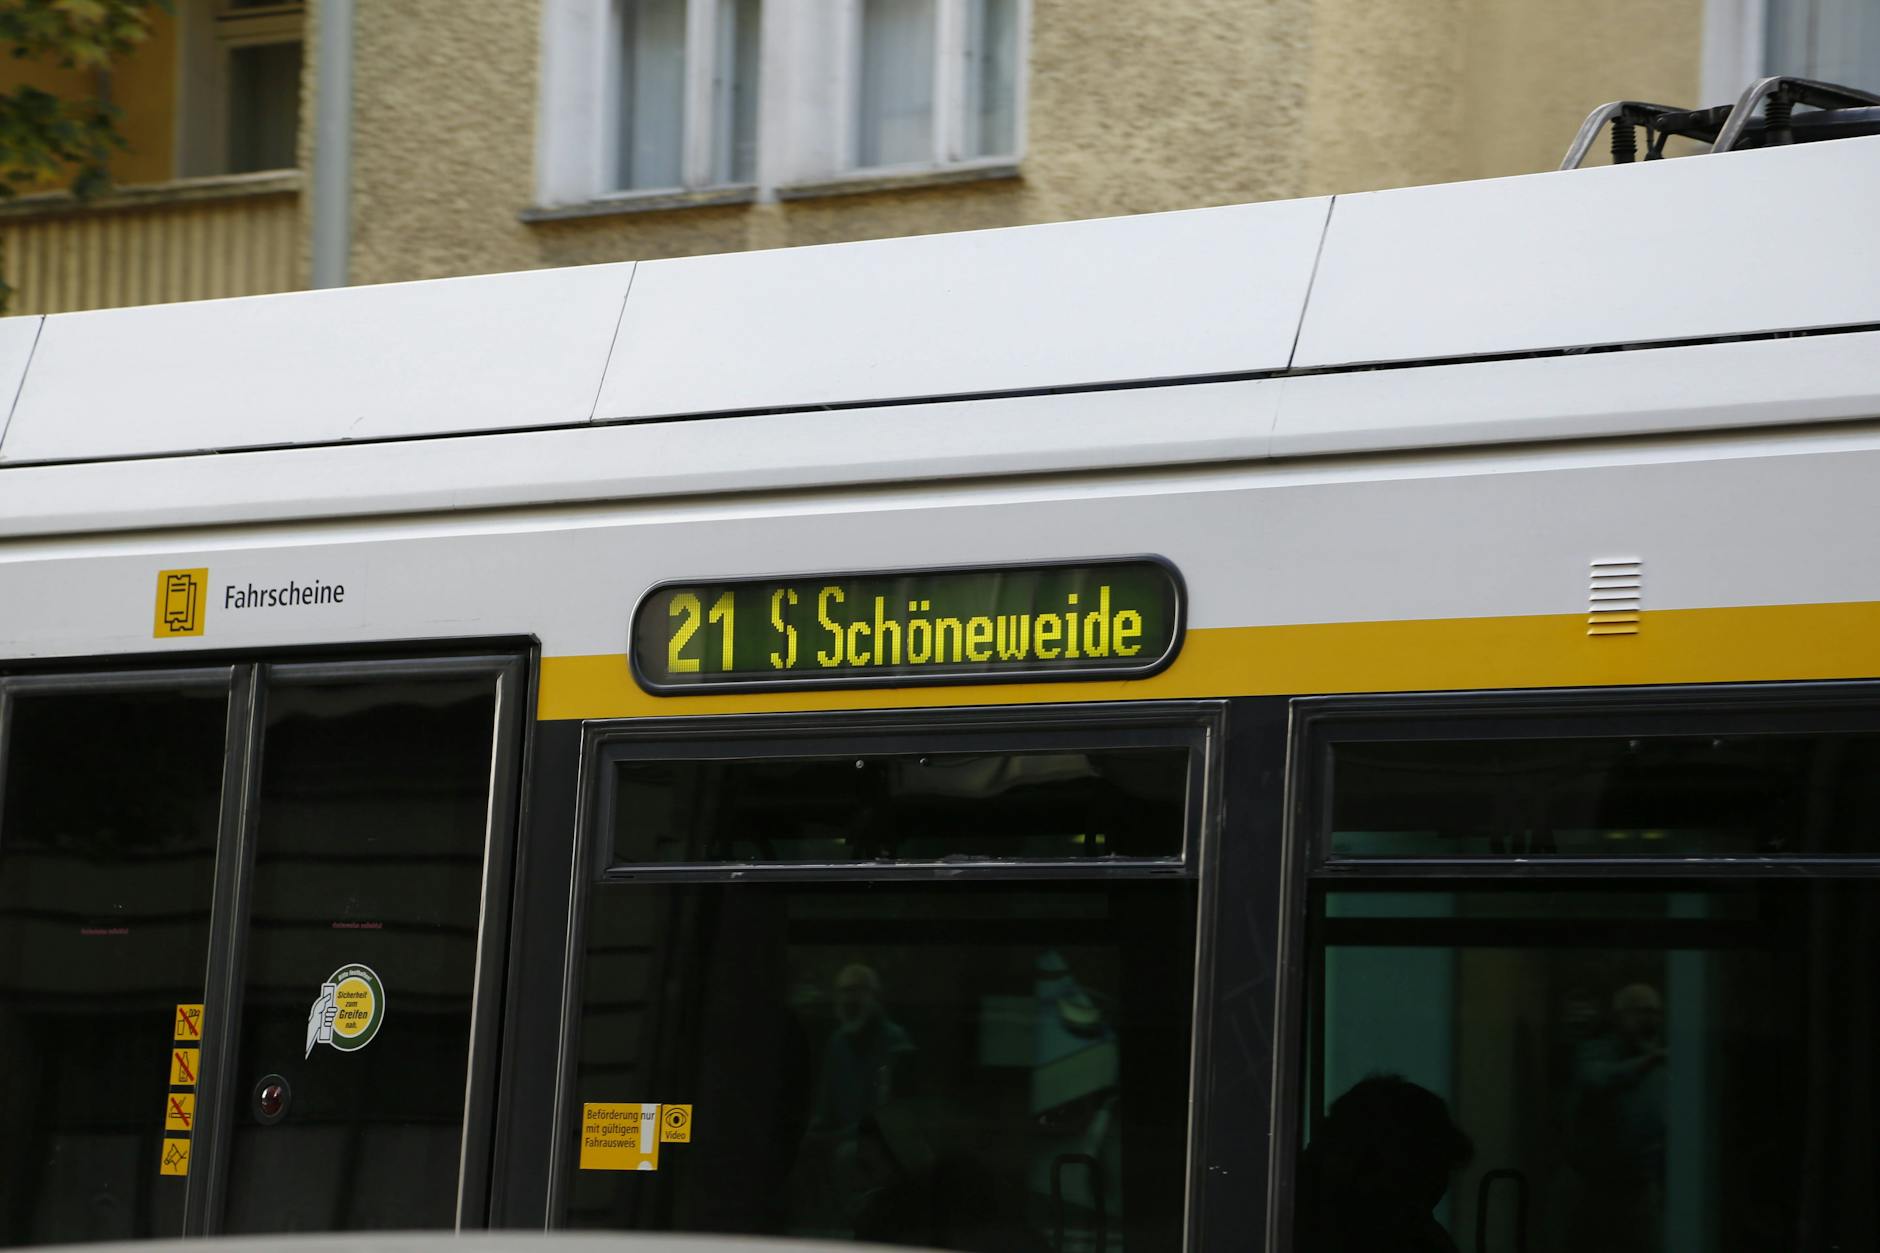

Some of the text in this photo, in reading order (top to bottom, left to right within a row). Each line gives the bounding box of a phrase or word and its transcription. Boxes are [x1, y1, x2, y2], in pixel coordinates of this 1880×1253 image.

[225, 579, 345, 609] Fahrscheine
[667, 585, 1143, 673] 21 S Schöneweide
[337, 991, 368, 999] Sicherheit
[339, 1010, 368, 1019] Greifen
[587, 1109, 655, 1122] Beförderung nur
[586, 1123, 639, 1136] mit gültigem
[665, 1131, 686, 1140] Video
[585, 1137, 636, 1148] Fahrausweis
